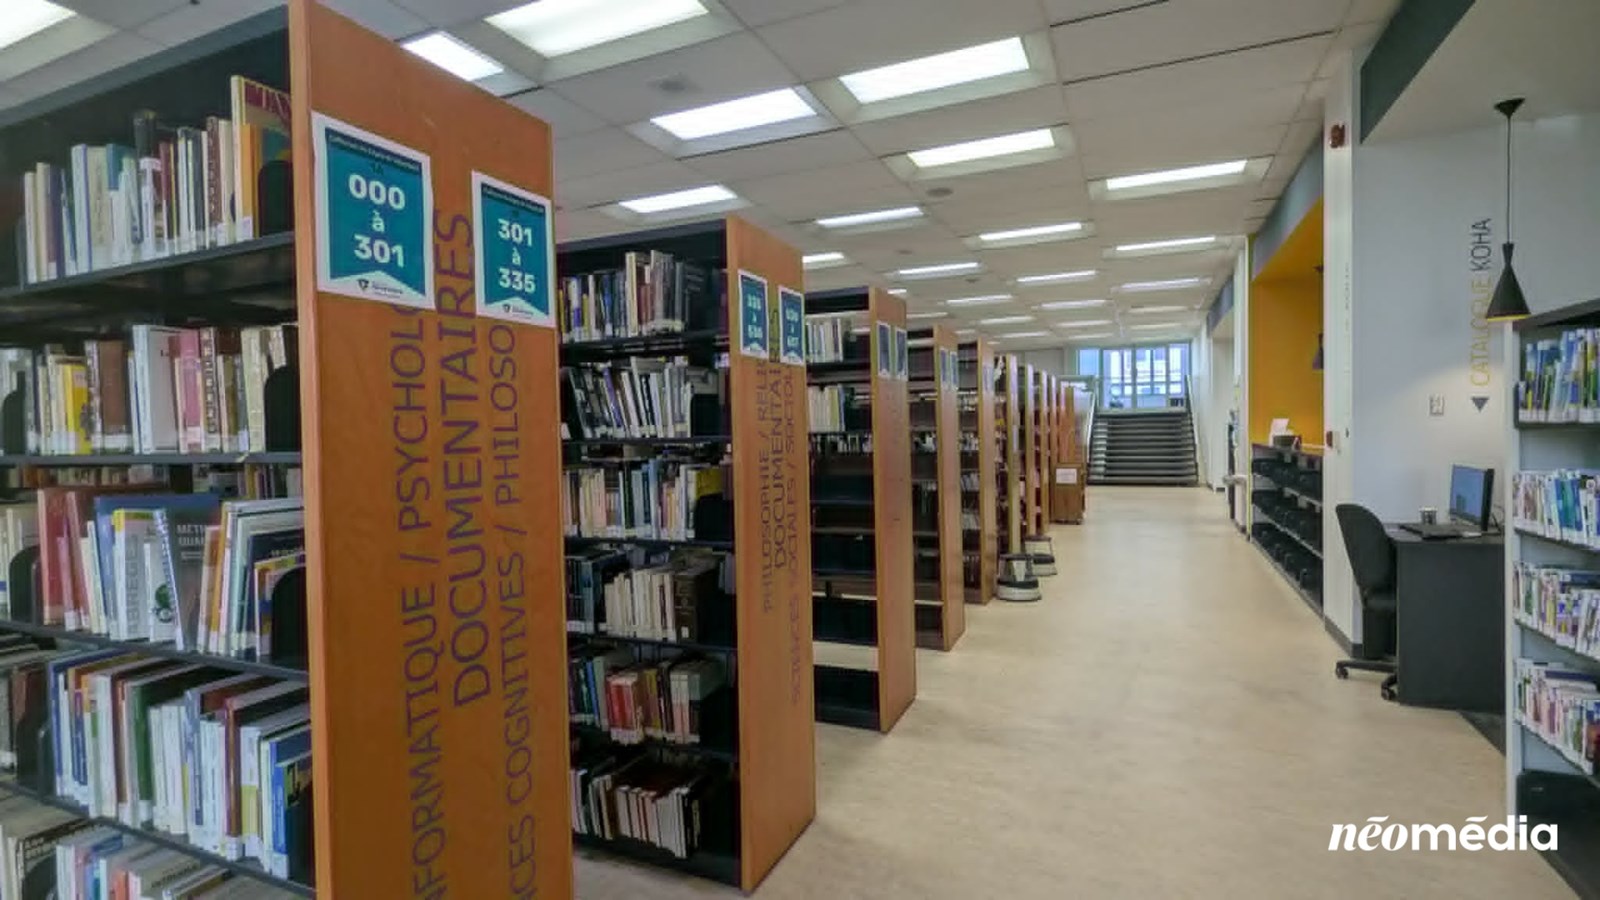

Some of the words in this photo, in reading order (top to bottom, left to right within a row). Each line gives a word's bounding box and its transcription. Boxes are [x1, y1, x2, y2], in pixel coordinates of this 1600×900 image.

[348, 173, 406, 211] 000
[371, 210, 385, 233] à
[497, 217, 533, 247] 301
[1469, 218, 1493, 272] KOHA
[353, 233, 405, 268] 301
[511, 248, 521, 266] à
[499, 267, 536, 294] 335
[488, 324, 523, 507] PHILOSO
[783, 364, 796, 454] SOCIOL
[432, 208, 492, 707] DOCUMENTAIRES
[769, 309, 787, 569] DOCUMENTAIRES
[758, 449, 773, 613] PHILOSOPHIE
[498, 551, 533, 805] COGNITIVES
